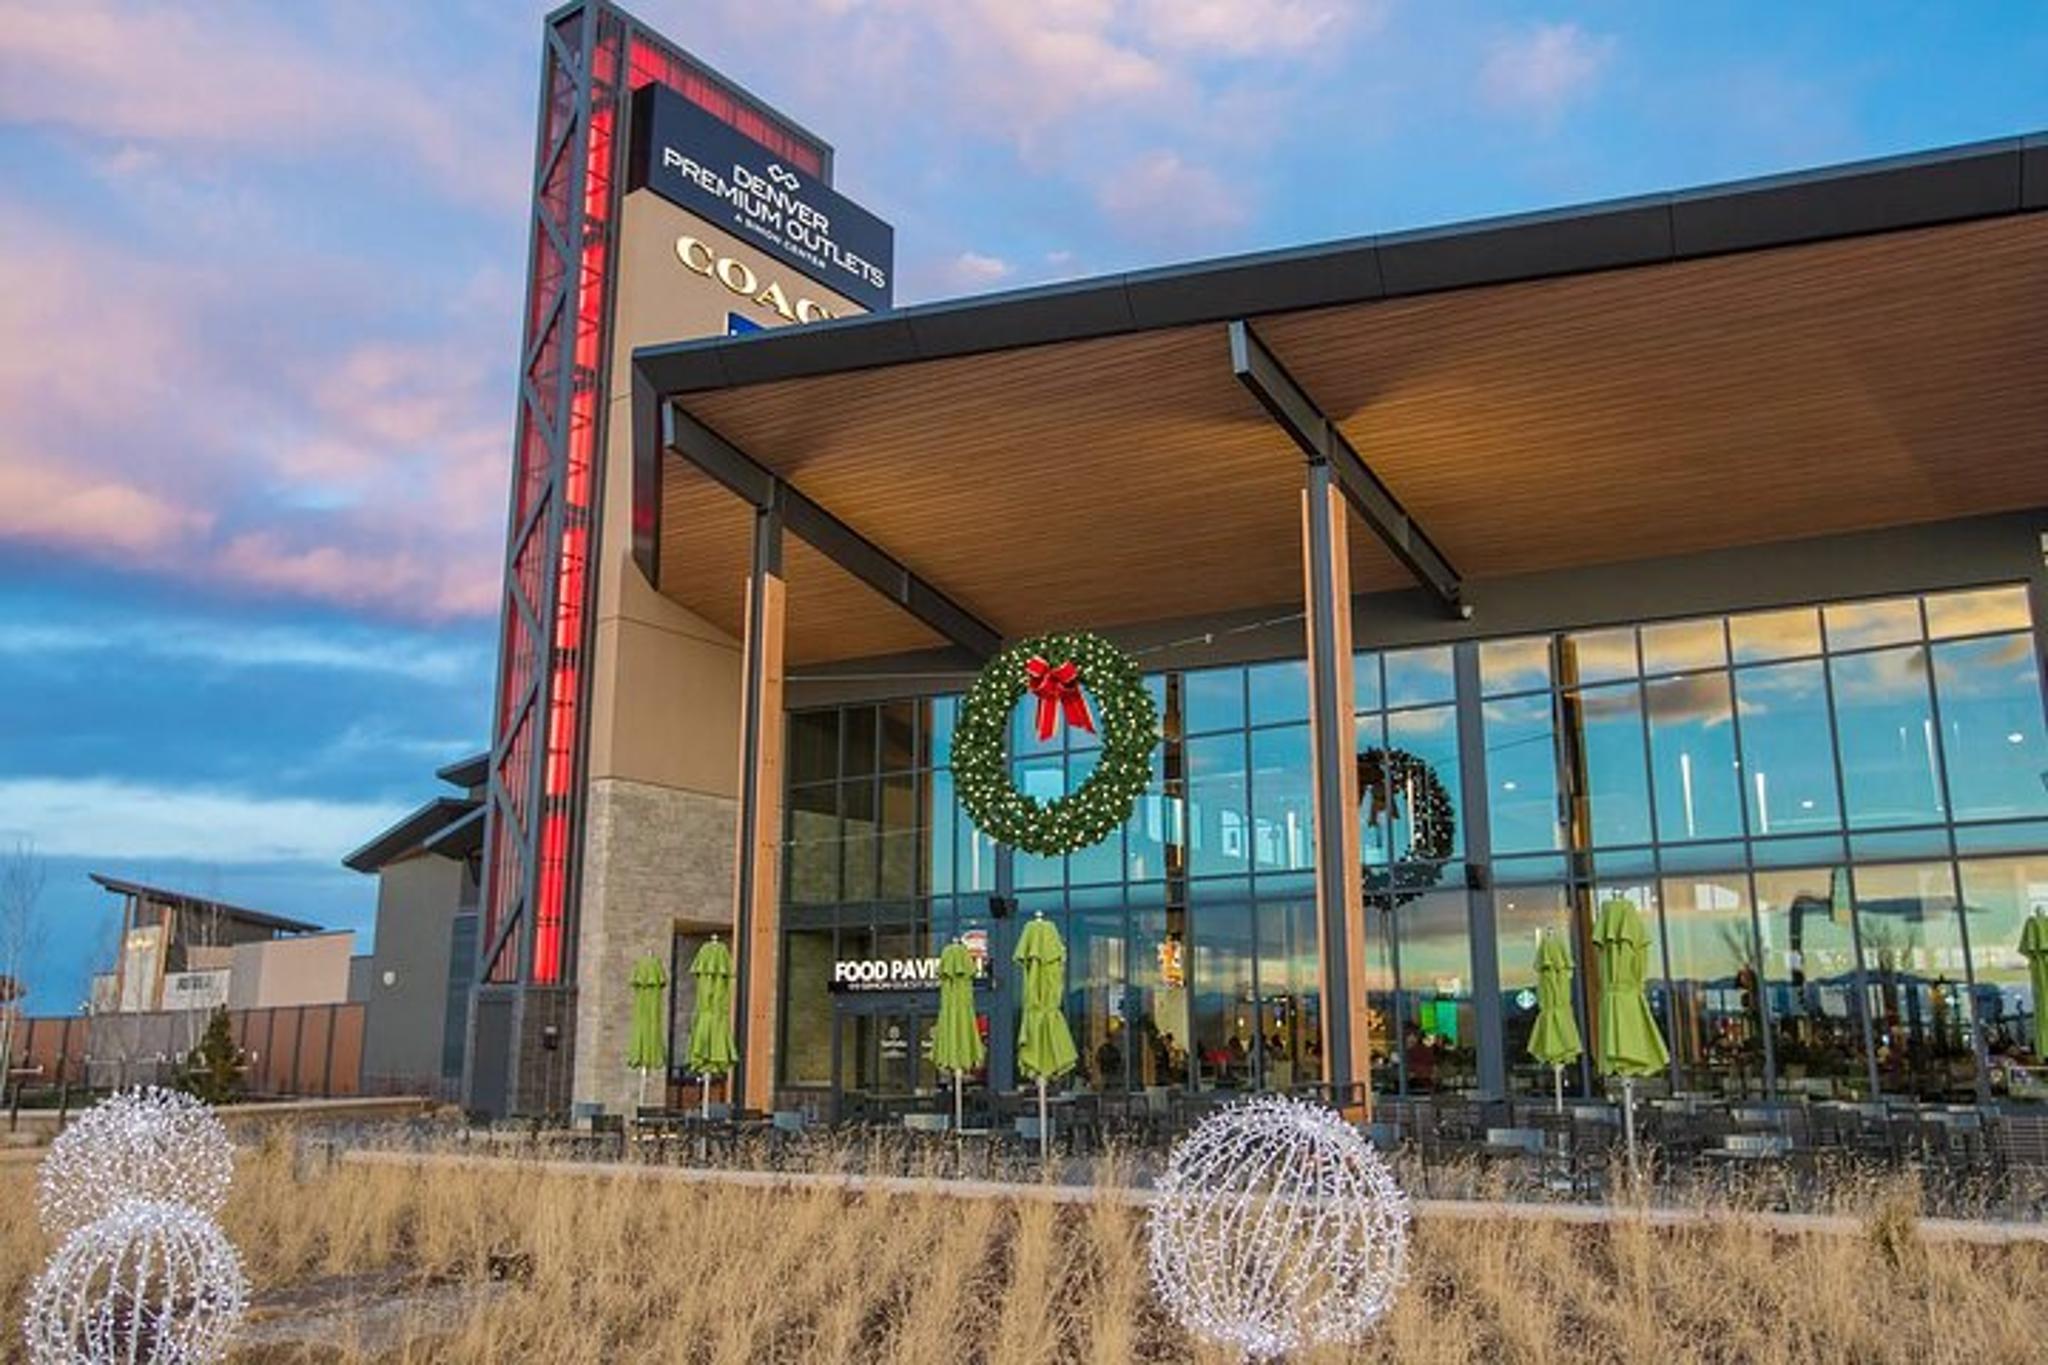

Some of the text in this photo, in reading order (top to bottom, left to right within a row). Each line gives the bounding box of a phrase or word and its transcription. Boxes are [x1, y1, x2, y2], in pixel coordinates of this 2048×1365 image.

[663, 147, 886, 289] PREMIUM OUTLETS
[733, 164, 829, 235] DENVER
[675, 235, 830, 325] COAC
[835, 957, 941, 982] FOOD PAVI
